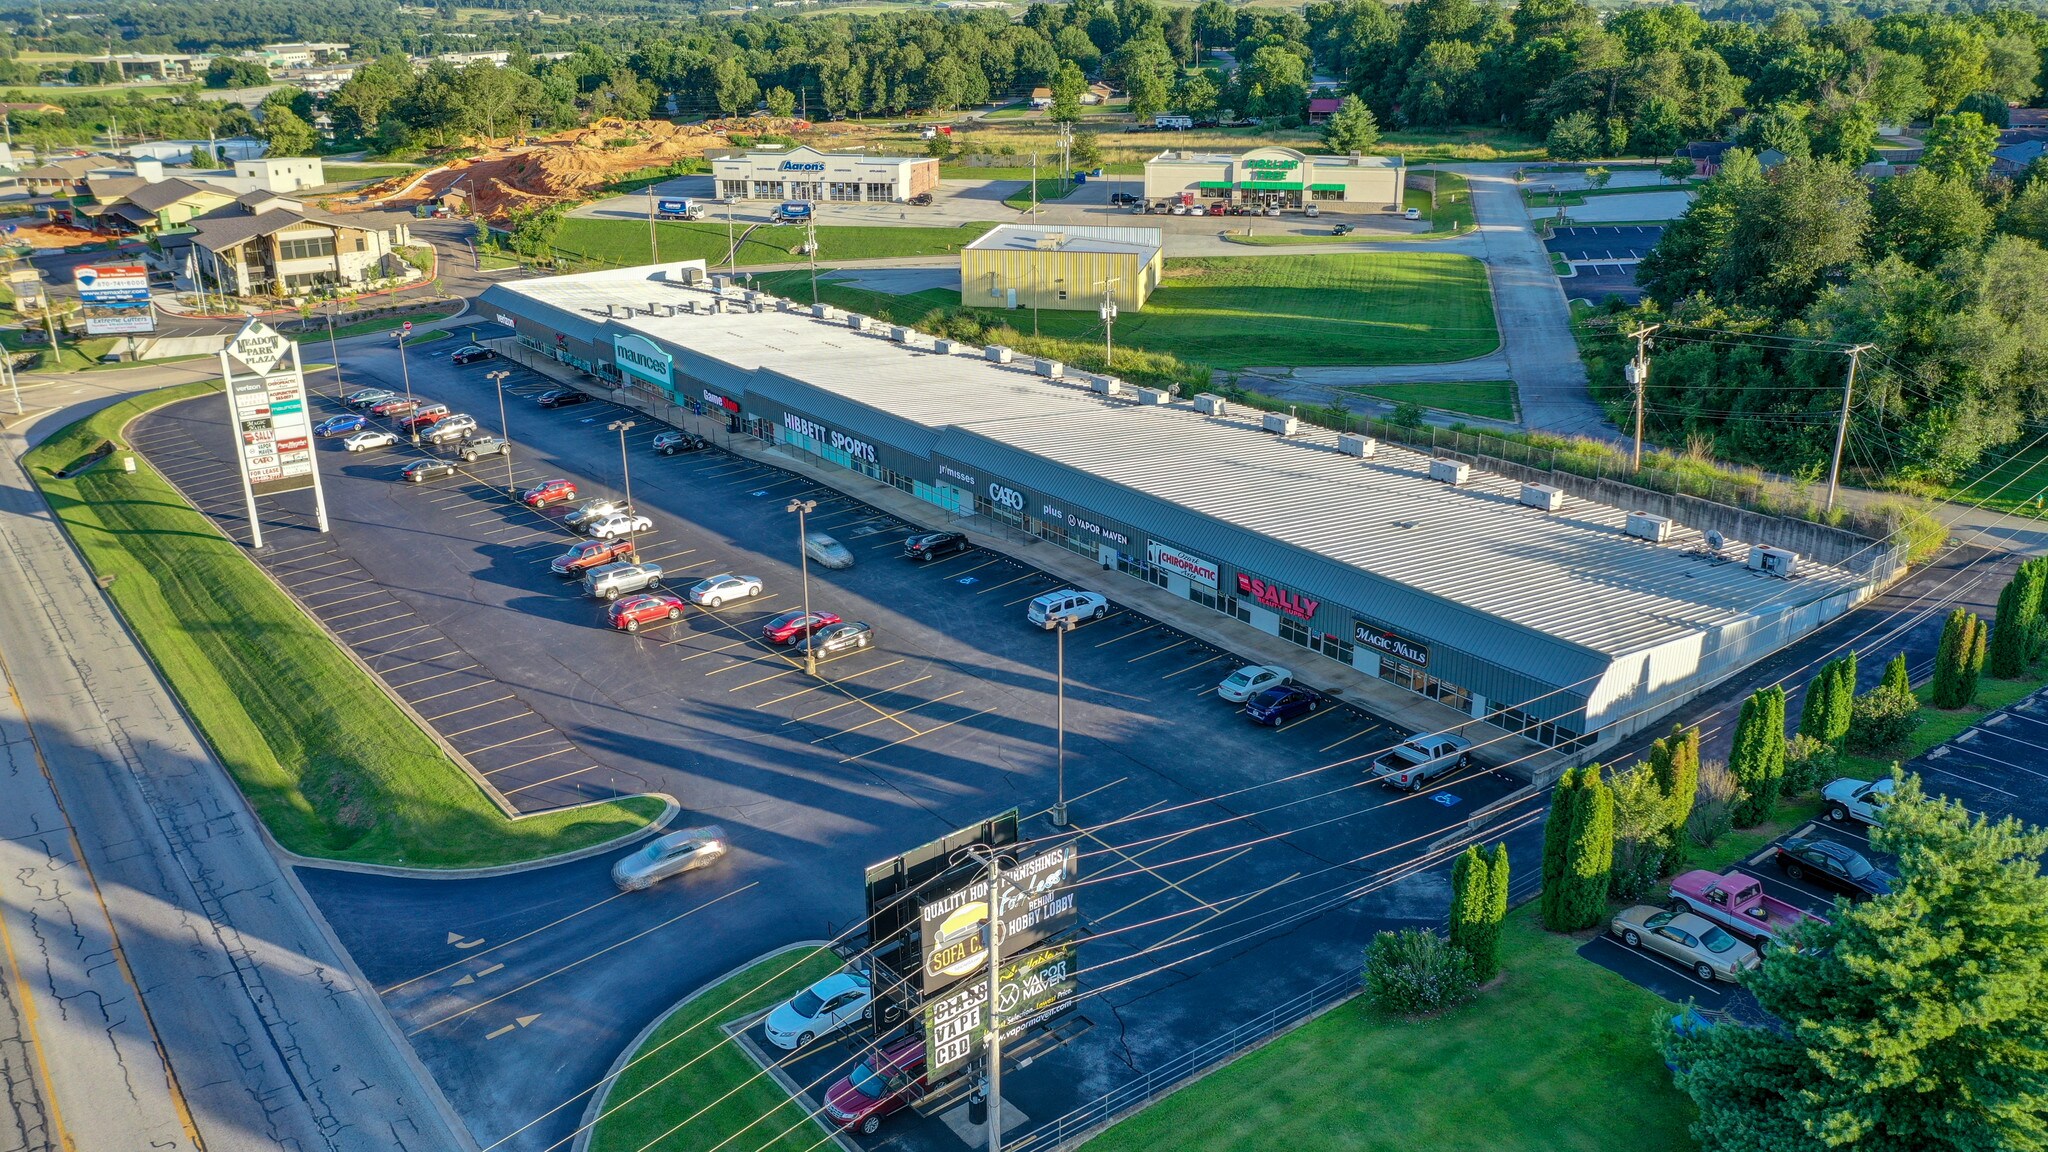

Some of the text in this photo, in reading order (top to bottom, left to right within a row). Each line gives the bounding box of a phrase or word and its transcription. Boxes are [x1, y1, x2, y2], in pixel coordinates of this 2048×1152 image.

[783, 160, 825, 171] Aaron's
[1247, 159, 1298, 169] DOLLAR
[1256, 171, 1287, 181] TREE
[496, 314, 514, 328] verizon
[236, 336, 279, 354] MEADOW
[246, 346, 273, 356] PARK
[245, 355, 277, 364] PLAZA
[235, 384, 261, 392] verizon
[703, 389, 740, 413] GameStop
[254, 430, 274, 441] SALLY
[784, 412, 875, 463] HIBBETT SPORTS
[252, 456, 274, 464] CATO
[989, 482, 1024, 511] CATO
[1043, 504, 1063, 519] plus
[1076, 519, 1128, 545] VAPOR MAVEN
[1161, 552, 1216, 581] CHIROPRACTIC
[1177, 551, 1199, 565] Ozark
[1181, 570, 1197, 580] Arts
[1251, 578, 1319, 617] SALLY
[1257, 596, 1311, 621] BEAUTY SUPPLY
[1356, 627, 1392, 650] MAGIC
[1392, 641, 1426, 664] NAILS
[924, 889, 969, 922] QUALITY
[1029, 890, 1055, 911] BEHIND
[1009, 893, 1074, 936] HOBBY LOBBY
[934, 943, 966, 971] SOFA
[1023, 960, 1066, 989] VAPOR
[1023, 972, 1066, 1000] MAVEN
[935, 984, 988, 1021] GLASS
[1036, 995, 1057, 1009] Lowest
[935, 1010, 979, 1043] VAPE
[936, 1038, 969, 1066] CBD
